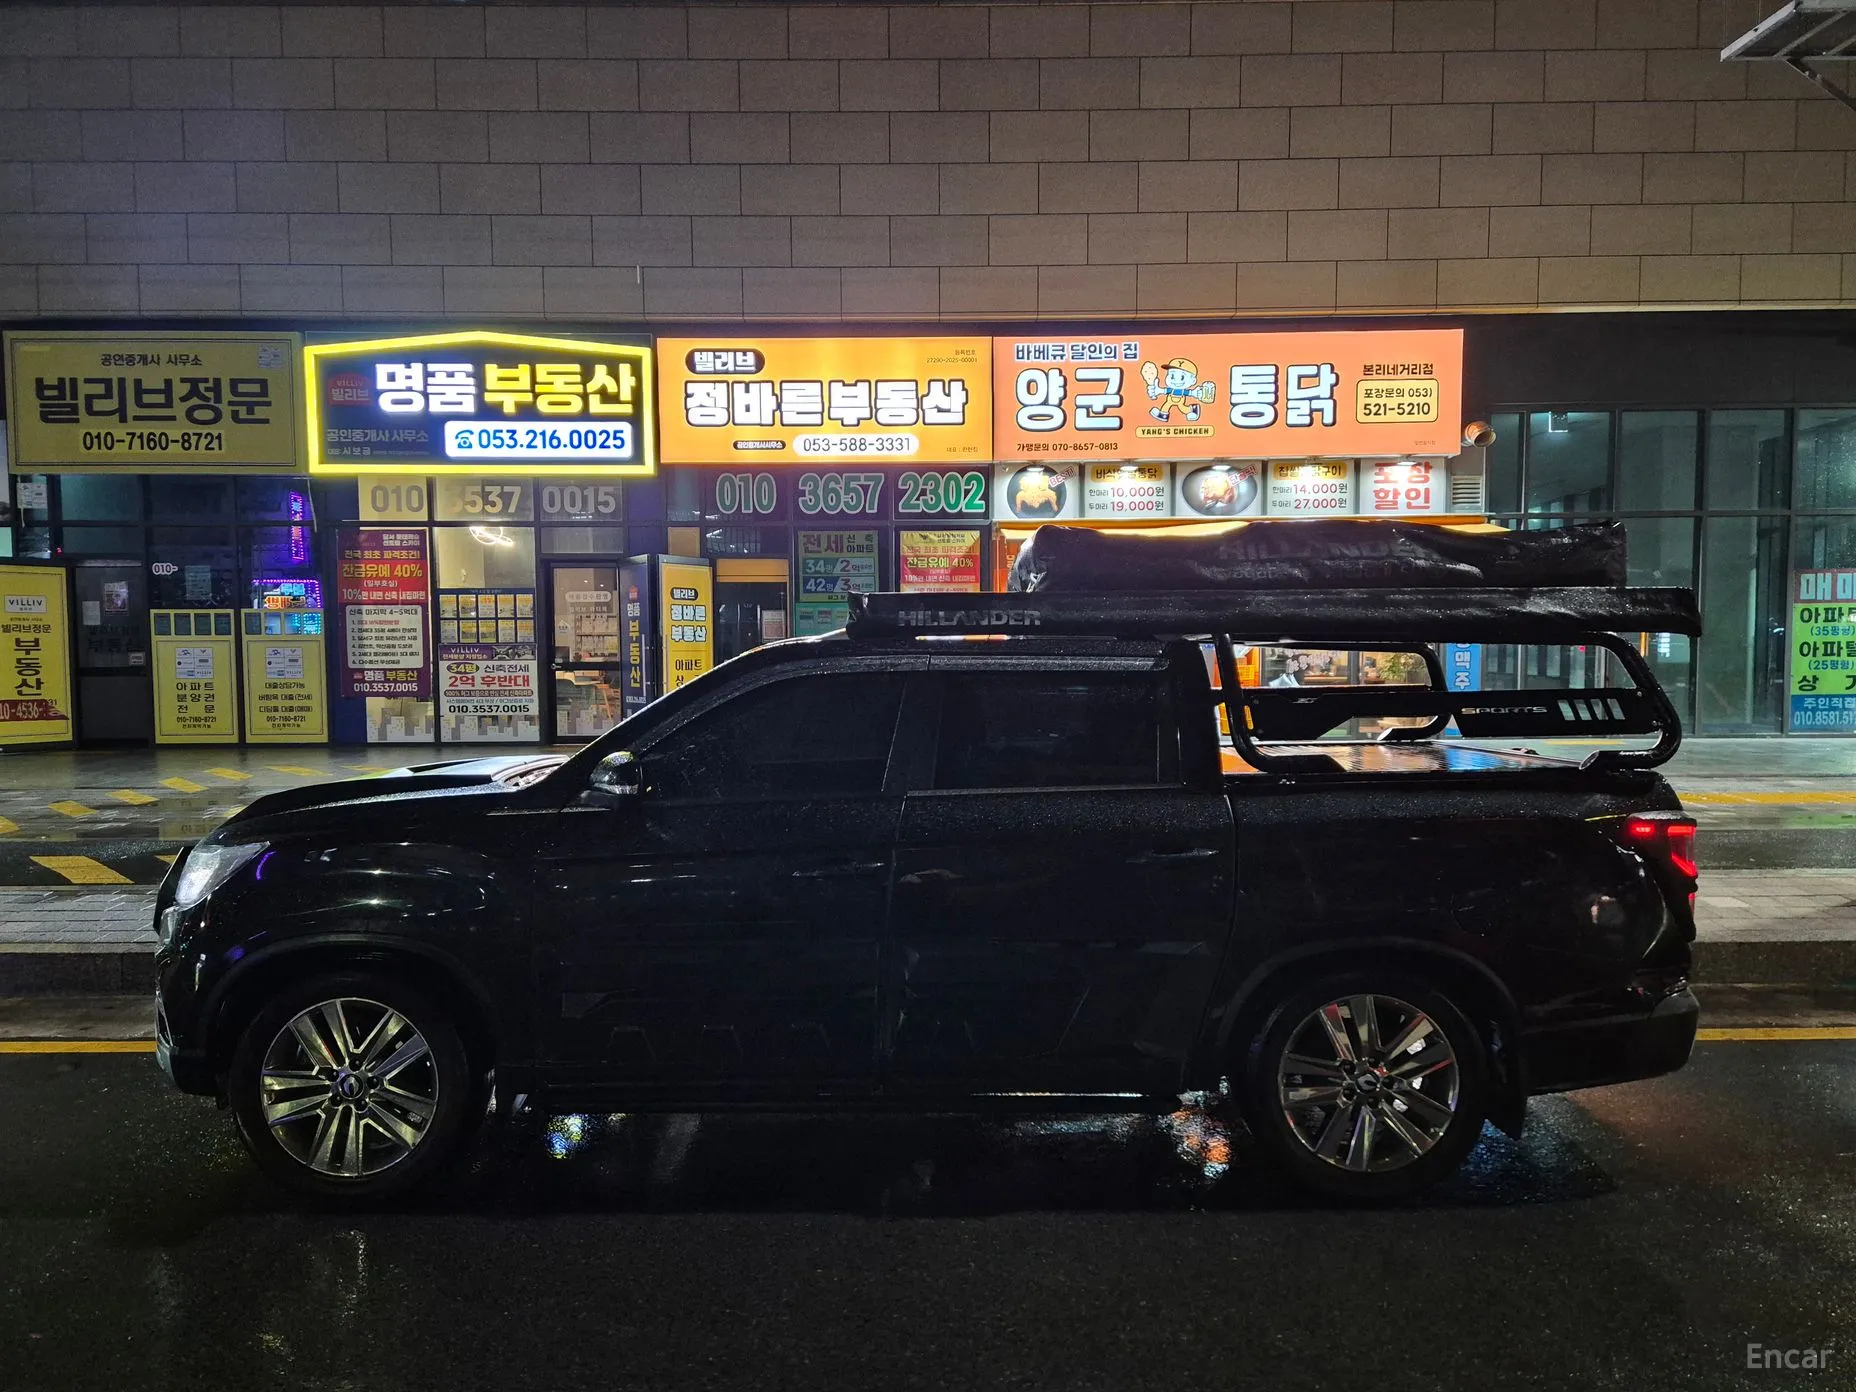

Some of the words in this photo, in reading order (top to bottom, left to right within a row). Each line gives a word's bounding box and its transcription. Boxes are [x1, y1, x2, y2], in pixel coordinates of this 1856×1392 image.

[1014, 343, 1067, 362] 바베큐
[1070, 343, 1120, 362] 달인의
[1122, 342, 1140, 361] 집
[101, 354, 161, 367] 공인중개사
[167, 354, 203, 367] 사무소
[693, 351, 756, 373] 빌리브
[1363, 363, 1435, 377] 본리네거리점
[331, 388, 372, 401] 빌리브
[375, 362, 477, 414] 명품
[484, 363, 637, 415] 부동산
[1363, 387, 1406, 399] 포장문의
[1407, 386, 1434, 400] 053)
[34, 376, 273, 426] 빌리브정문
[1014, 367, 1124, 432] 양군
[1228, 362, 1340, 430] 통닭
[684, 379, 969, 428] 정바른부동산
[1362, 402, 1431, 418] 521-5210
[325, 429, 390, 442] 공인중개사
[392, 429, 429, 442] 사무소
[1173, 427, 1210, 436] CHICKEN
[82, 431, 224, 452] 010-7160-8721
[477, 429, 626, 450] 053.216.0025
[802, 437, 912, 453] 053-588-3331
[1052, 442, 1119, 452] 070-8657-0813
[370, 485, 424, 513] 010
[542, 485, 617, 514] 0015
[716, 473, 777, 514] 010
[798, 473, 885, 515] 3657
[898, 472, 986, 513] 2302
[1373, 487, 1431, 511] 할인
[1110, 500, 1165, 512] 19,000원
[1294, 498, 1348, 510] 27,000원
[952, 557, 974, 568] 40%
[393, 563, 423, 578] 40%
[8, 599, 43, 607] VILLIV
[898, 609, 1042, 627] HILLANDER
[1, 623, 51, 634] 빌리브정문
[14, 637, 45, 697] 부동산
[675, 659, 702, 671] 아파트
[1455, 643, 1471, 690] 맥주
[386, 670, 418, 681] 부동산
[449, 675, 476, 688] 2억
[480, 674, 530, 688] 후반대
[176, 682, 215, 691] 아파트
[353, 683, 418, 692] 010.3537.0015
[448, 704, 530, 713] 010.3537.0015
[1461, 706, 1548, 715] SPORTS
